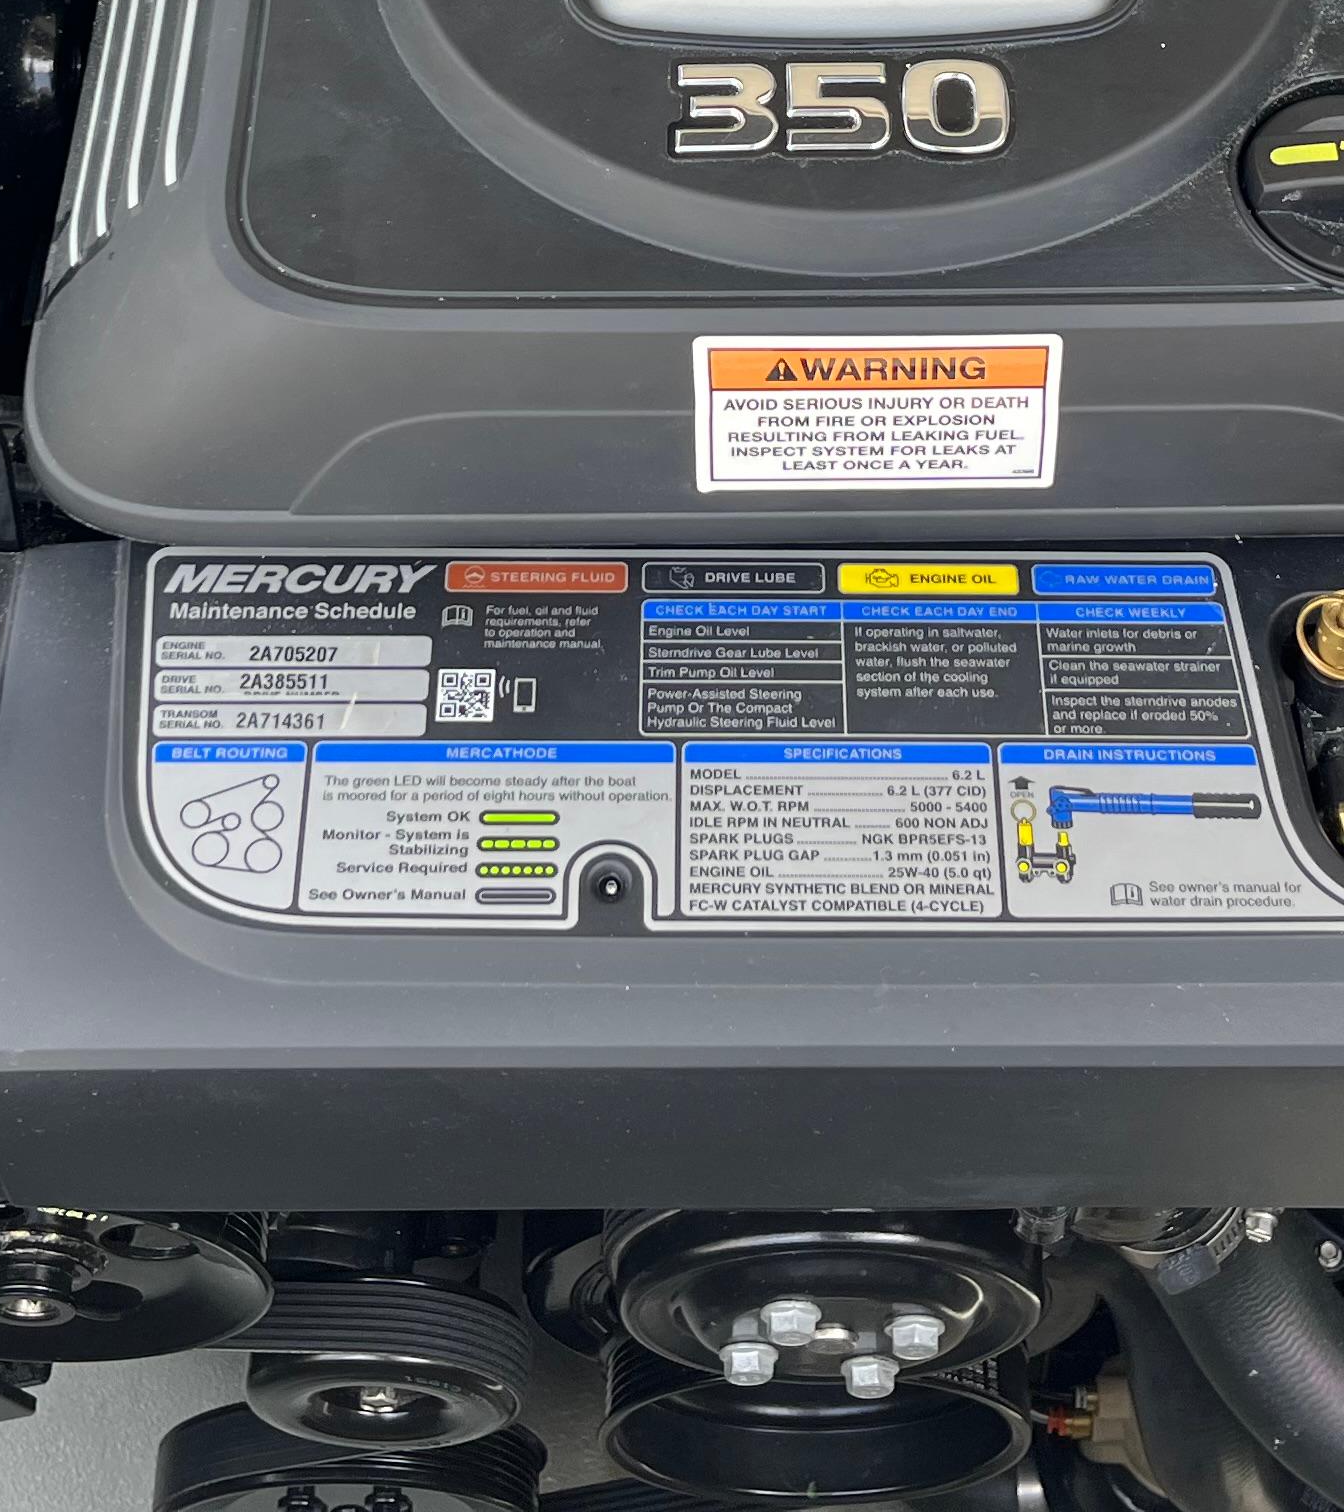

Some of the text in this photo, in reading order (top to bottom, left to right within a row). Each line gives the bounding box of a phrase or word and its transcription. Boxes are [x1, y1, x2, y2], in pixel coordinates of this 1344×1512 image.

[670, 60, 1011, 156] 350
[800, 357, 985, 380] WARNING
[723, 396, 1029, 411] AVOID SERIOUS INJURY OR DEATH
[758, 414, 995, 427] FROM FIRE OR EXPLOSION
[728, 429, 1024, 443] RESULTING FROM LEAKING FUEL.
[730, 444, 1016, 457] INSPECT SYSTEM FOR LEAKS AT
[783, 459, 968, 471] LEAST ONCE A YEAR.
[162, 563, 438, 593] MERCURY
[490, 572, 616, 583] STEERING FLUID
[705, 572, 796, 584] DRIVE LUBE
[910, 574, 996, 584] ENGINE OIL
[1065, 575, 1209, 585] RAW WATER DRAIN
[169, 601, 416, 620] Maintenance Schedule
[656, 605, 827, 616] CHECK EACH DAY START
[861, 606, 1017, 617] CHECK EACH DAY END
[1075, 608, 1186, 617] CHECK WEEKLY
[162, 641, 205, 650] ENGINE
[161, 651, 202, 660] SERIAL
[249, 646, 339, 663] 2A705207
[648, 648, 819, 659] Sterndrive Gear Lube Level
[160, 685, 201, 694] SERIAL
[240, 674, 329, 690] 2A385511
[161, 675, 197, 684] DRIVE
[160, 710, 218, 718] TRANSOM
[159, 720, 200, 729] SERIAL
[236, 712, 326, 730] 2A714361
[171, 748, 288, 759] BELT ROUTING
[446, 747, 557, 759] MERCATHODE
[783, 748, 902, 760] SPECIFICATIONS
[1043, 749, 1216, 761] DRAIN INSTRUCTIONS
[690, 769, 985, 781] MODEL 6.2 L
[690, 785, 987, 799] DISPLACEMENT 6.2 L (377 CID)
[689, 801, 725, 812] MAX.
[729, 801, 773, 812] W.O.T.
[777, 802, 809, 812] RPM
[910, 802, 942, 813] 5000
[956, 802, 988, 813] 5400
[386, 811, 471, 823] System OK
[689, 817, 988, 830] IDLE RPM IN NEUTRAL 600 NON ADJ
[689, 834, 986, 845] SPARK PLUGS NGK BPR5EFS-13
[689, 850, 991, 864] SPARK PLUG GAP 1.3 mm (0.051 in)
[689, 866, 992, 881] ENGINE OIL 25W-40 (5.0 qt)
[308, 889, 466, 900] See Owner's Manual
[689, 883, 995, 896] MERCURY SYNTHETIC BLEND OR MINERAL
[689, 900, 984, 914] FC-W CATALYST COMPATIBLE (4-CYCLE)
